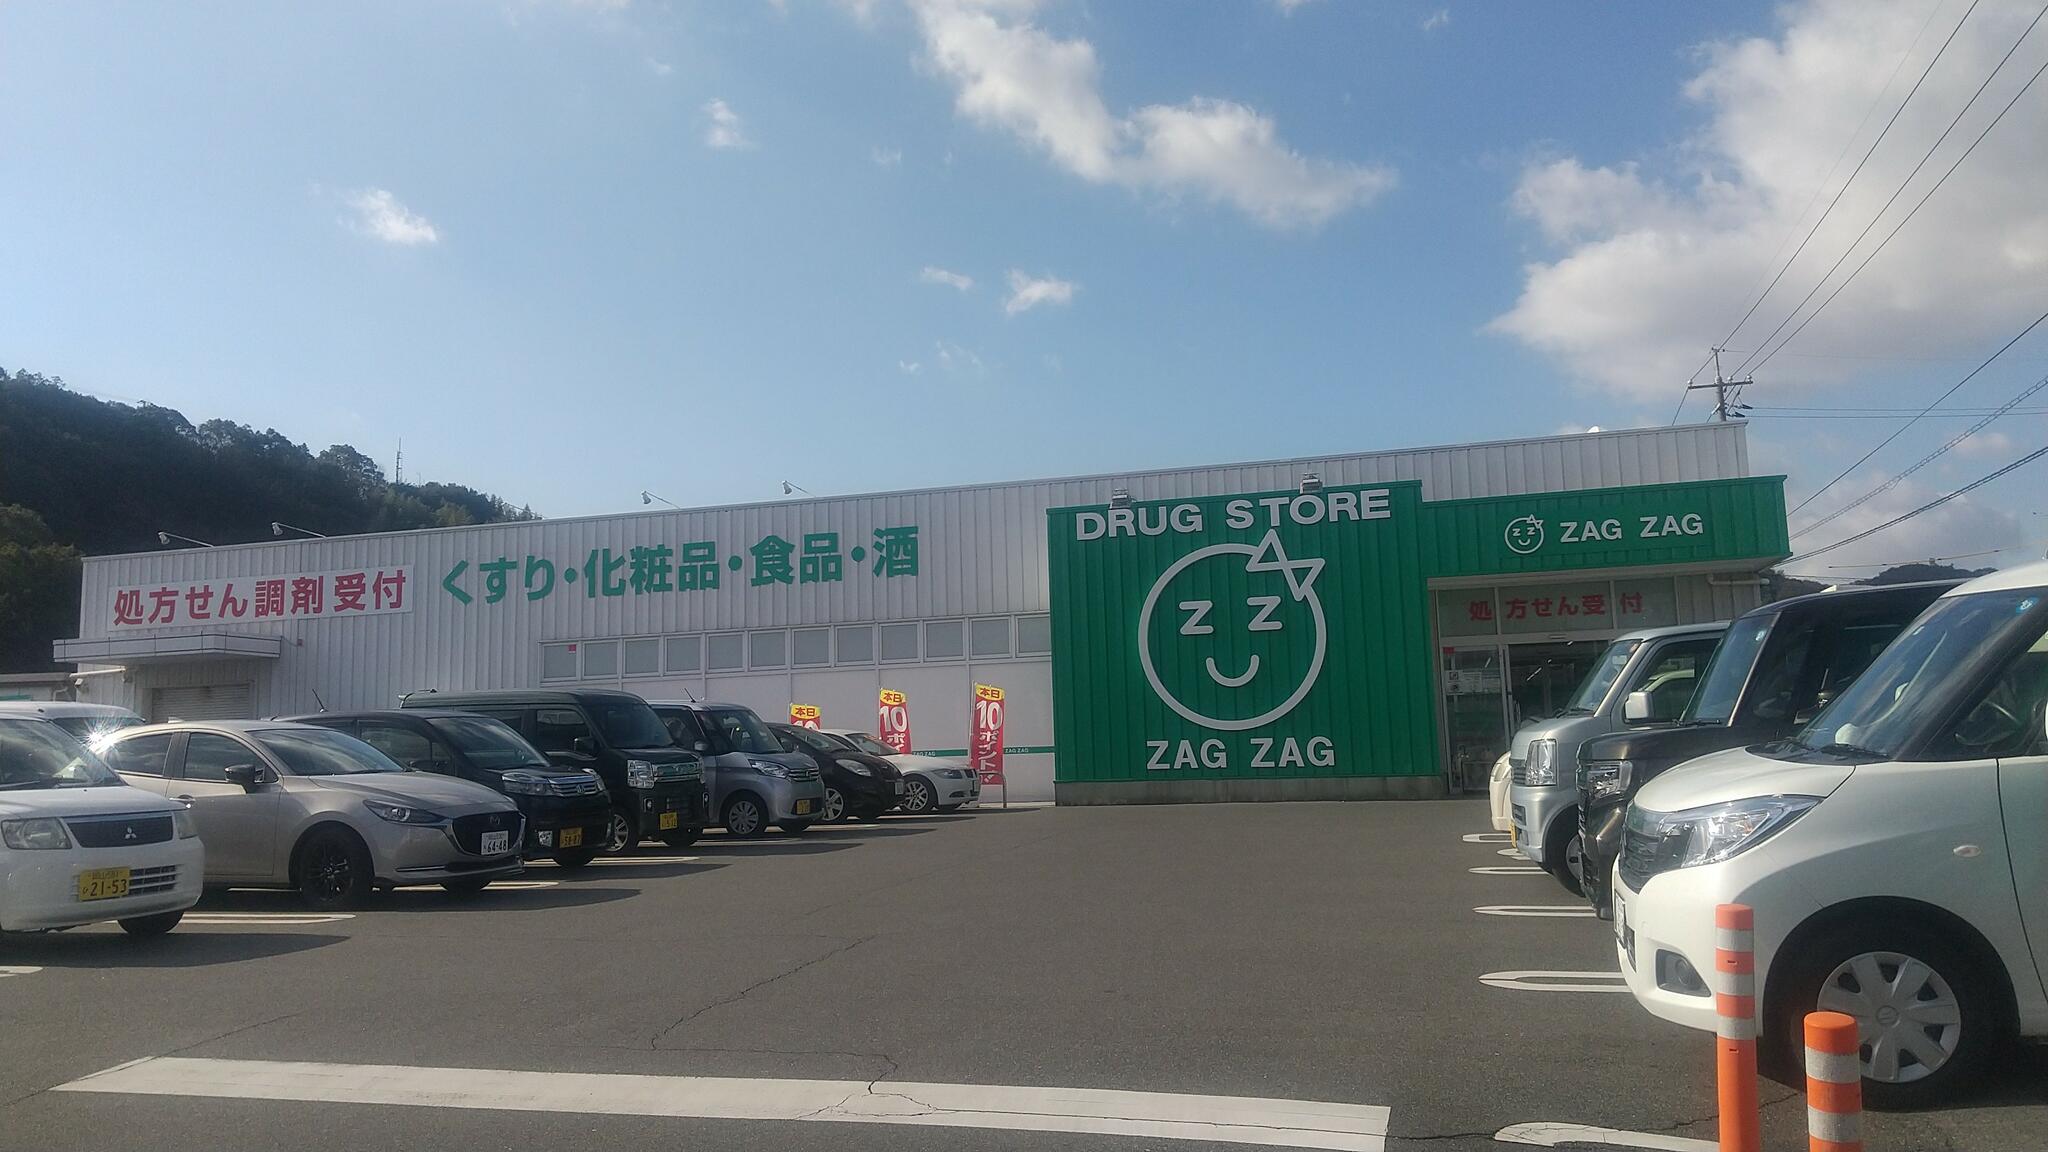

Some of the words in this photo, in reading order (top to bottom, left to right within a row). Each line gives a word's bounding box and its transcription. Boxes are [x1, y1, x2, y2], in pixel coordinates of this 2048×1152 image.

[1075, 503, 1203, 541] DRUG
[1226, 489, 1391, 529] STORE
[1560, 518, 1622, 543] ZAG
[1640, 513, 1704, 538] ZAG
[442, 526, 919, 605] くすり・化粧品・食品・酒
[113, 570, 407, 626] 処方せん調剤受付
[1468, 592, 1643, 622] 処方せん受付
[883, 692, 903, 703] 本日
[980, 687, 1000, 699] 本日
[795, 706, 816, 717] 本日
[879, 705, 908, 732] 10
[976, 700, 1003, 731] 10
[1147, 738, 1227, 770] ZAG
[1250, 736, 1336, 768] ZAG
[90, 879, 127, 896] 21-53
